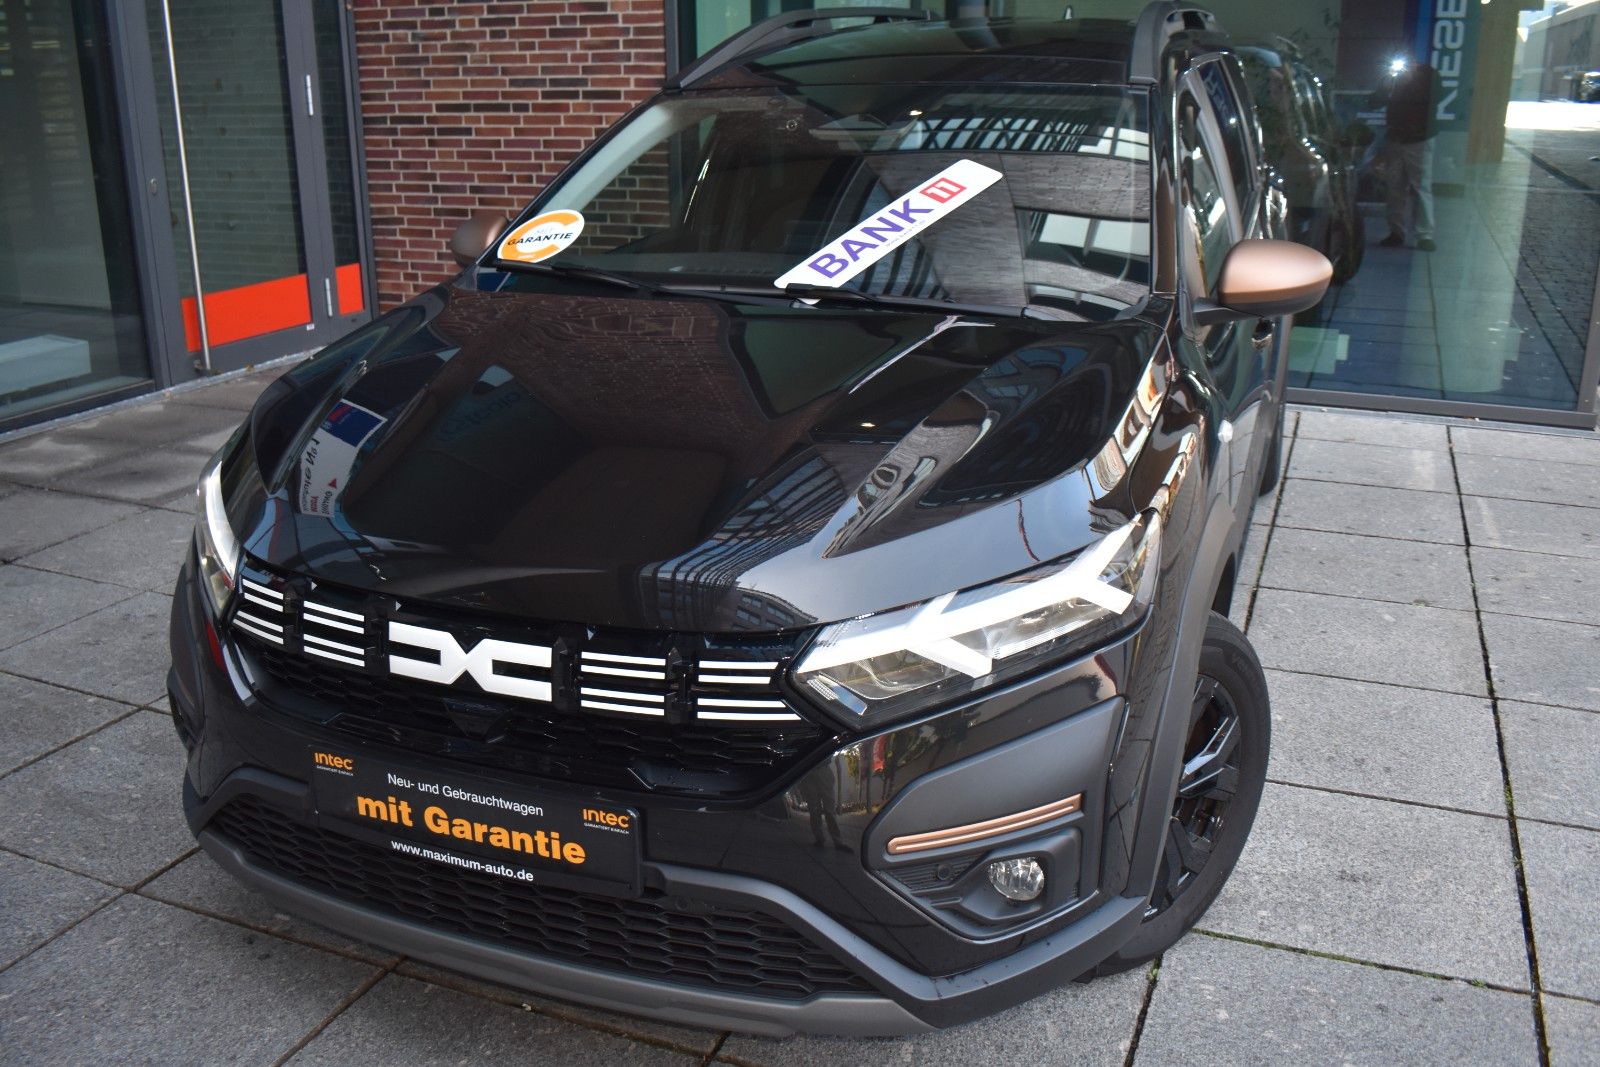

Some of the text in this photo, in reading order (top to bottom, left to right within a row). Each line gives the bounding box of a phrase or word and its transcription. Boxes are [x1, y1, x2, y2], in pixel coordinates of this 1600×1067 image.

[507, 231, 574, 246] GARANTIE
[808, 198, 935, 279] BANK
[923, 178, 964, 202] 11
[388, 773, 544, 817] Neu- und Gebrauchtwagen
[357, 794, 587, 865] mit Garantie
[391, 840, 534, 882] www.maximum-auto.de
